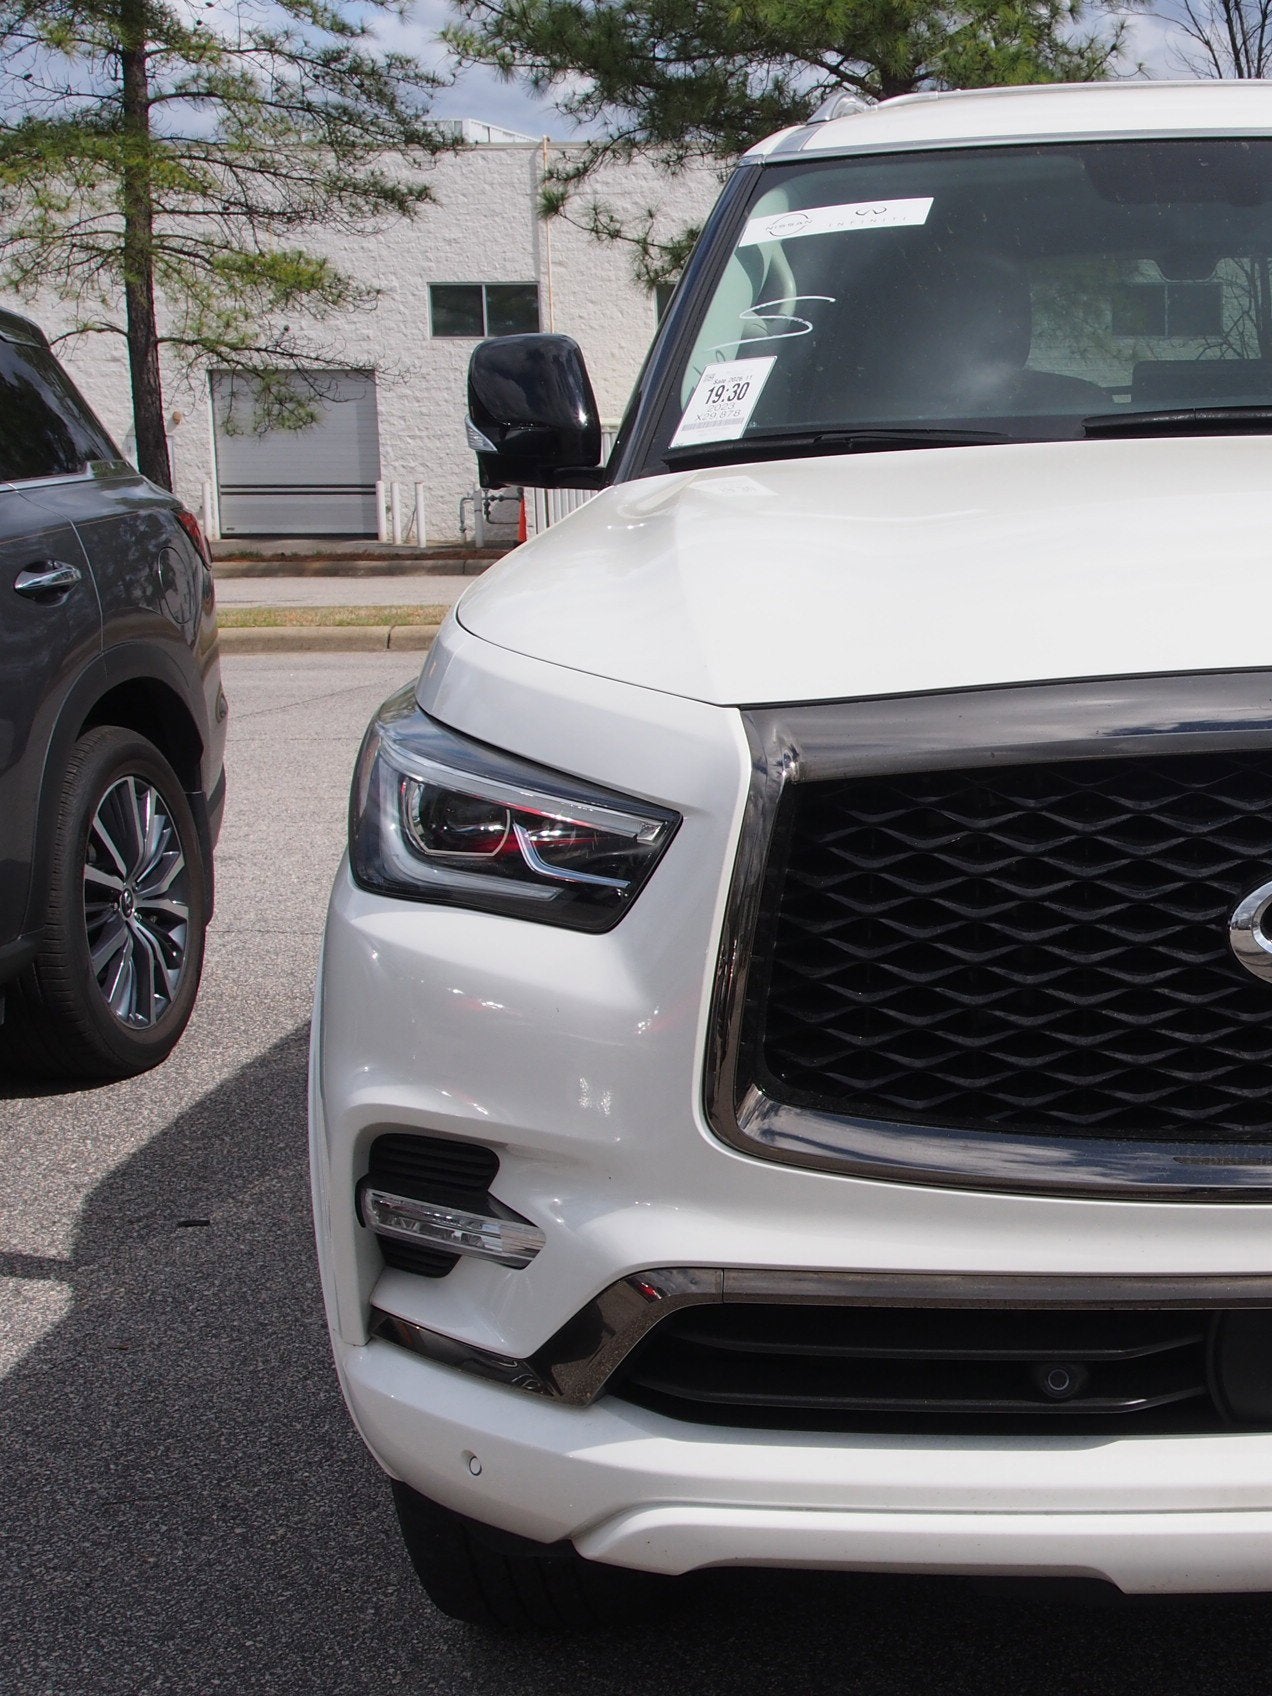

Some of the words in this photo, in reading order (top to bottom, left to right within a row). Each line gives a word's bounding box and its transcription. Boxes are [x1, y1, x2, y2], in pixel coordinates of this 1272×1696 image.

[765, 219, 813, 232] NISSAN
[828, 216, 907, 228] INFINITI
[704, 381, 750, 405] 19:30
[706, 402, 736, 412] 2023
